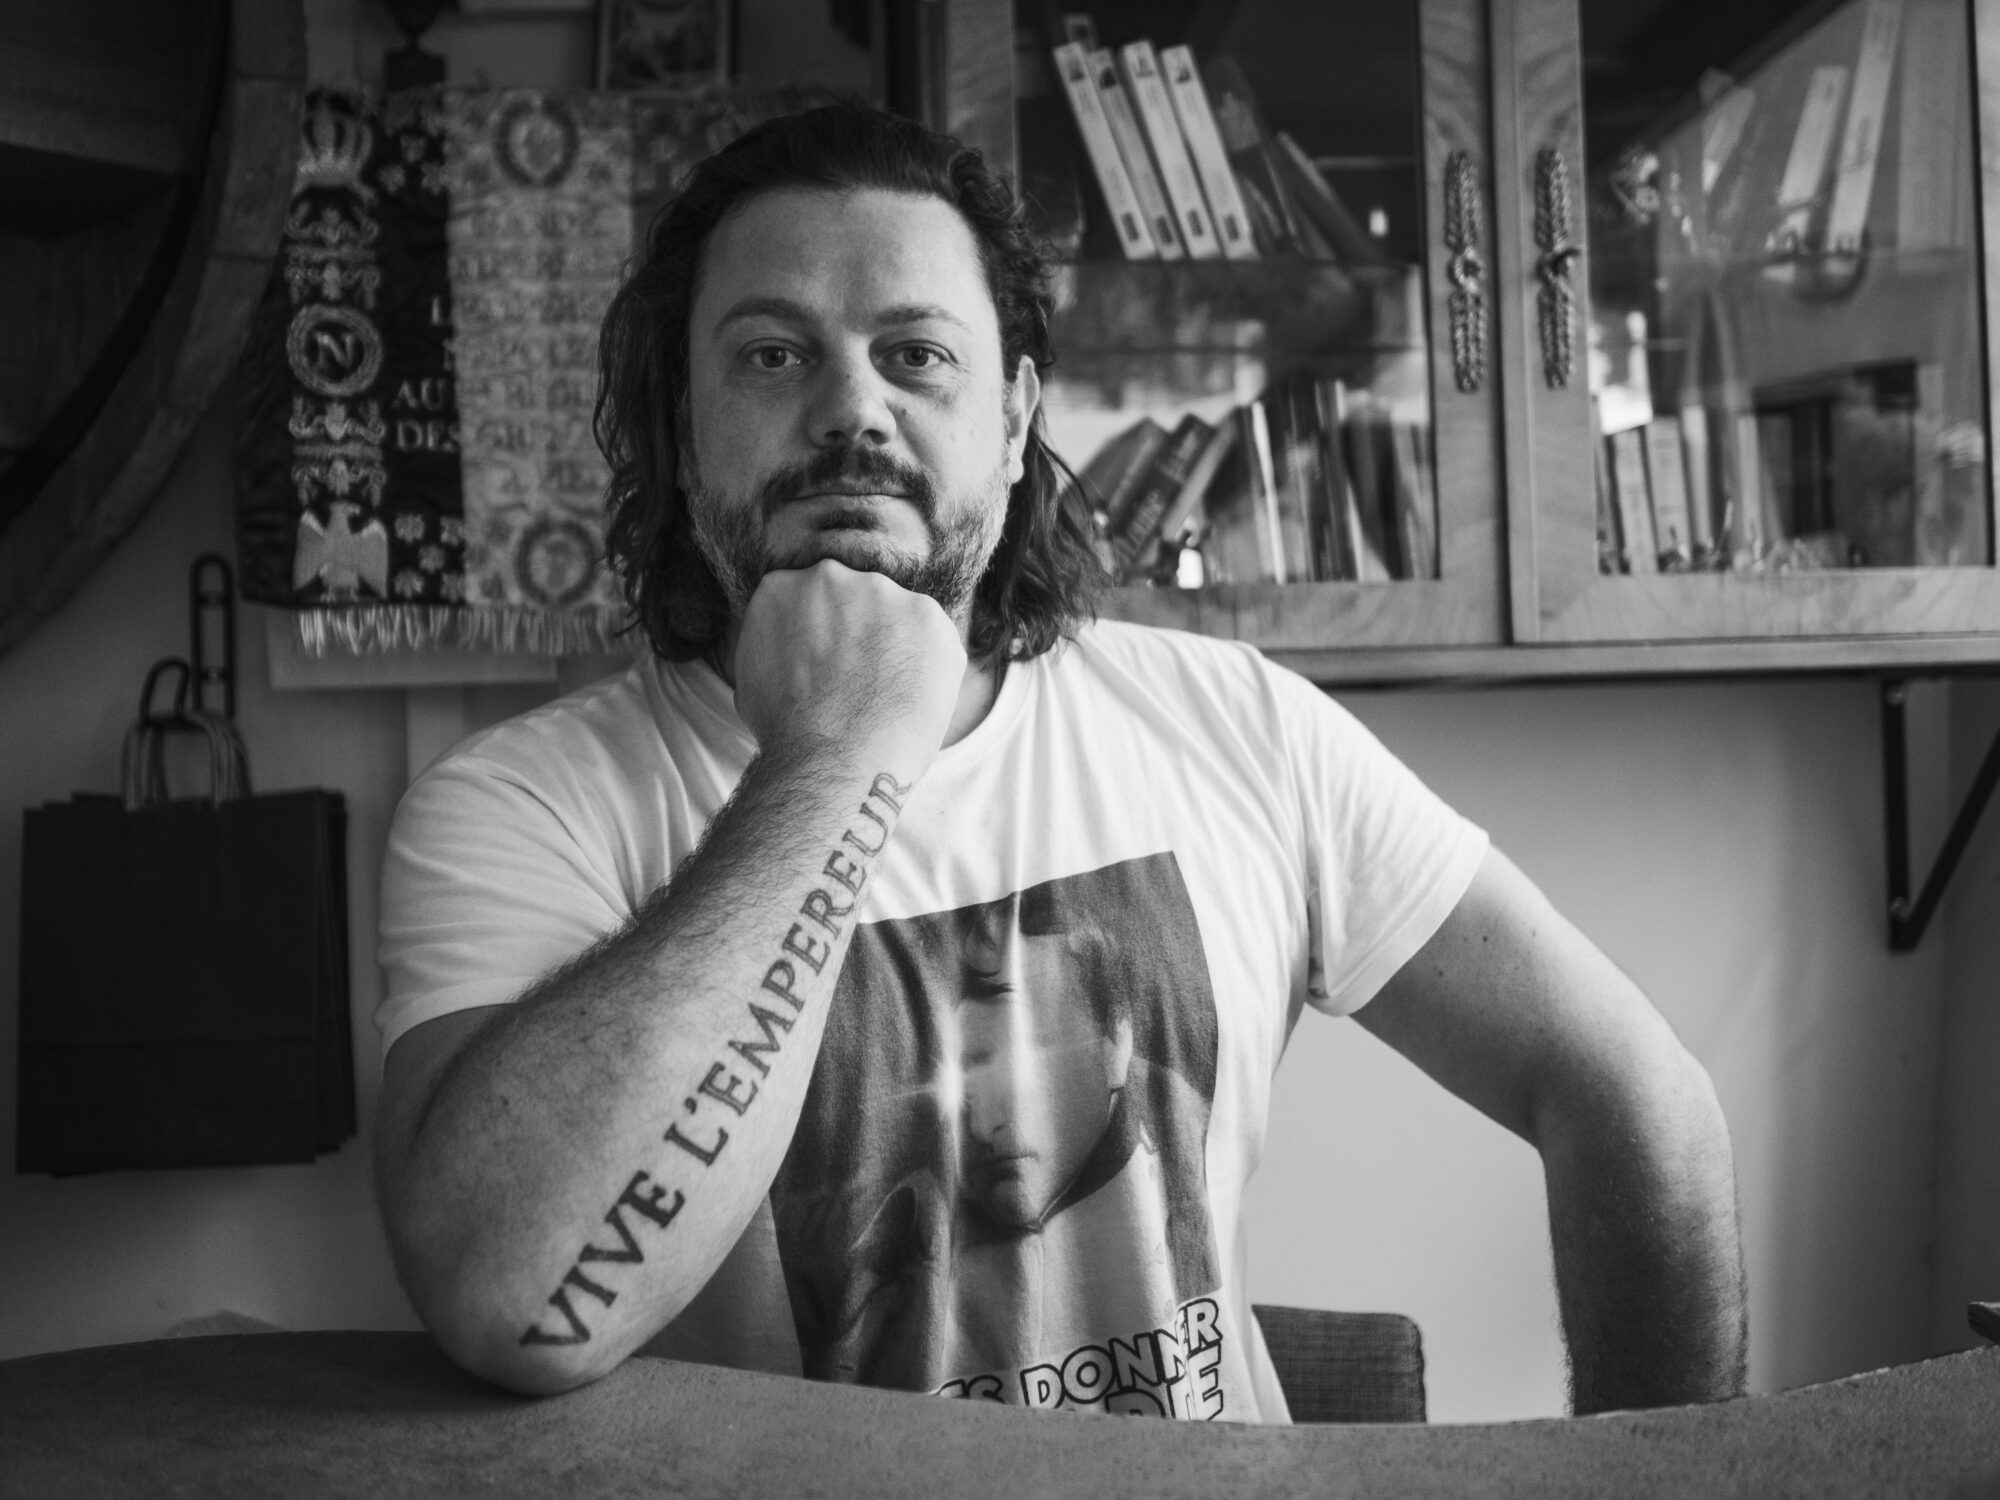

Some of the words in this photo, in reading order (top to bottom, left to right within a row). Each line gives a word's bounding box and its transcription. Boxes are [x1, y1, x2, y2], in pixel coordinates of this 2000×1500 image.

[313, 330, 356, 371] N
[518, 1170, 685, 1347] VIVE
[663, 771, 912, 1167] L'EMPEREUR
